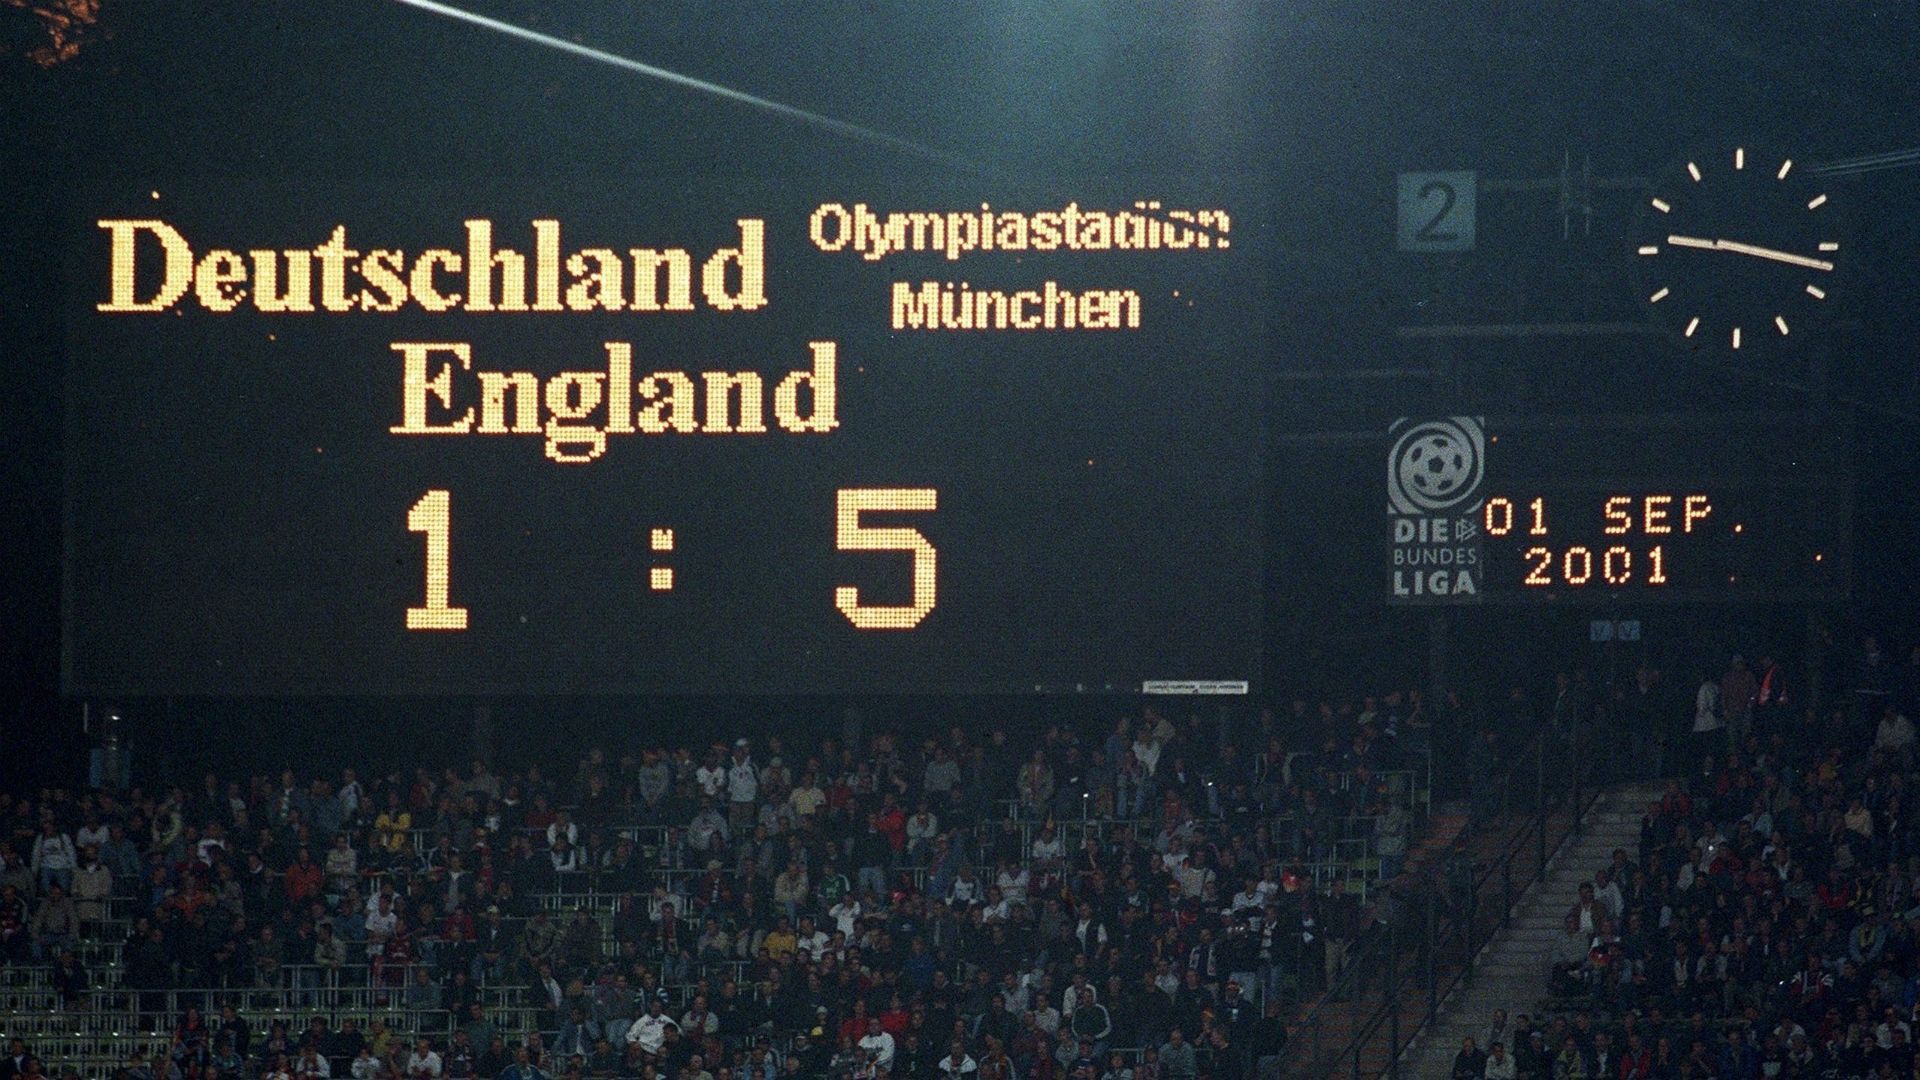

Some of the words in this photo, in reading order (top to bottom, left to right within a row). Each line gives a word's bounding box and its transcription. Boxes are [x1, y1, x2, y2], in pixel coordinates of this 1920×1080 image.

[809, 201, 1230, 261] Olympiastadion
[1415, 180, 1458, 242] 2
[96, 219, 769, 312] Deutschland
[892, 281, 1141, 330] München
[389, 342, 840, 463] England
[1394, 518, 1449, 543] DIE
[1485, 497, 1547, 535] 01
[406, 489, 468, 630] 1
[835, 488, 938, 629] 5
[1394, 549, 1476, 565] BUNDES
[1524, 545, 1666, 585] 2001
[1394, 570, 1477, 595] LIGA
